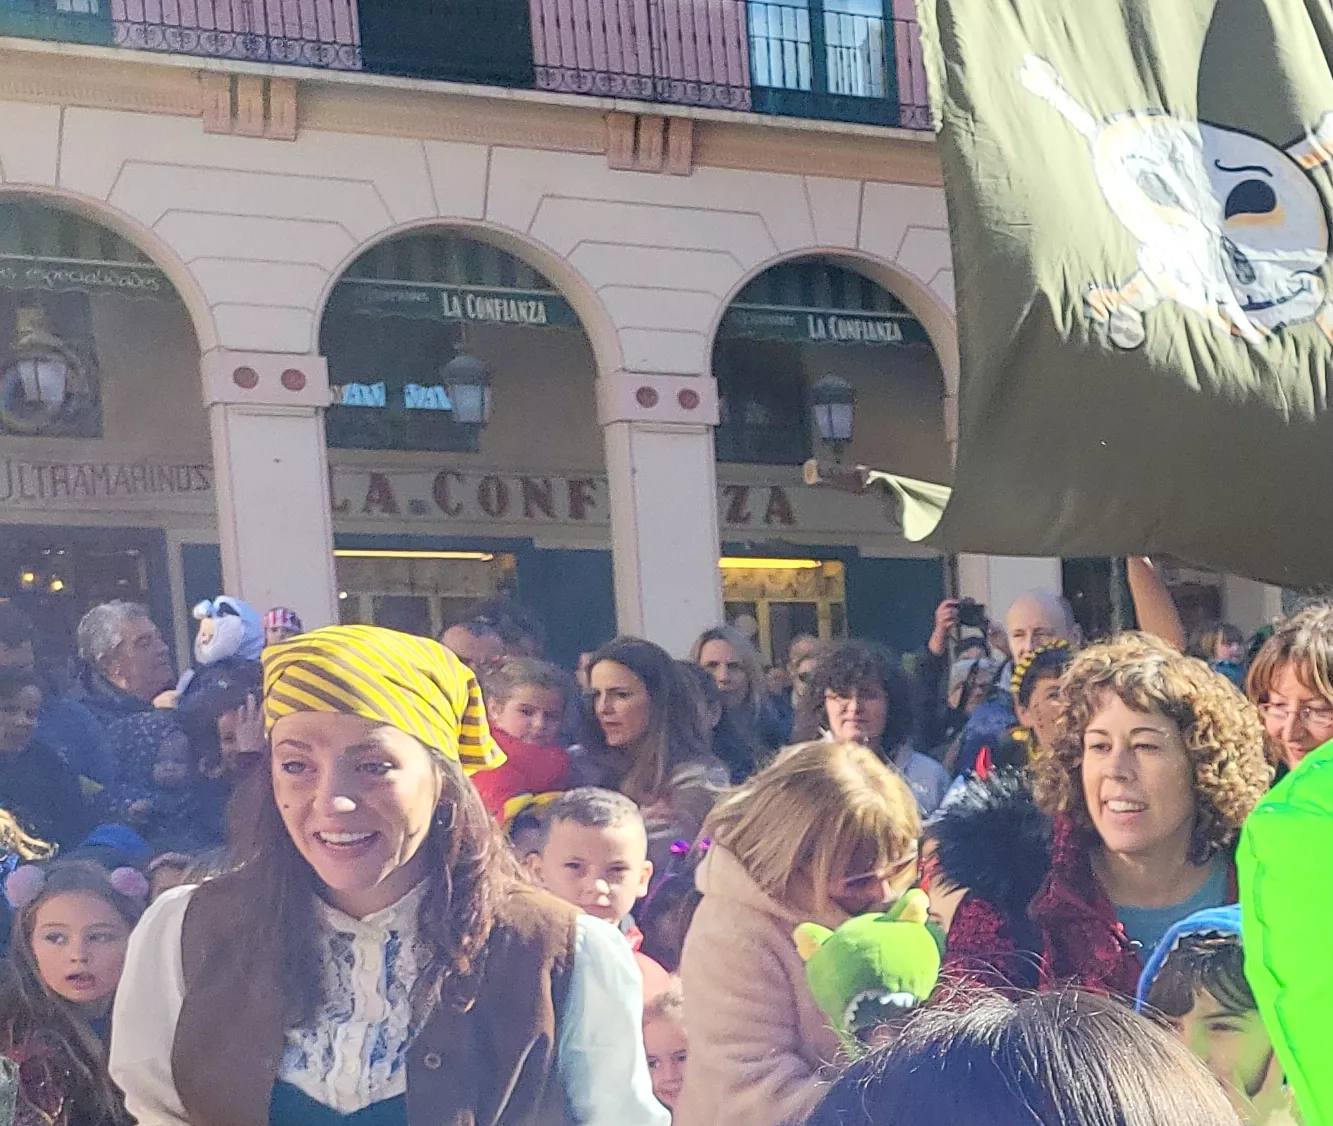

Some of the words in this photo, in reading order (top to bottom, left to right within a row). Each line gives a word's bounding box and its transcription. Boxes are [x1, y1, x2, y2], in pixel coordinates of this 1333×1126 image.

[442, 292, 462, 317] LA
[465, 293, 548, 325] CONFIANZA
[807, 314, 826, 341] LA
[828, 315, 903, 342] CONFIANZA
